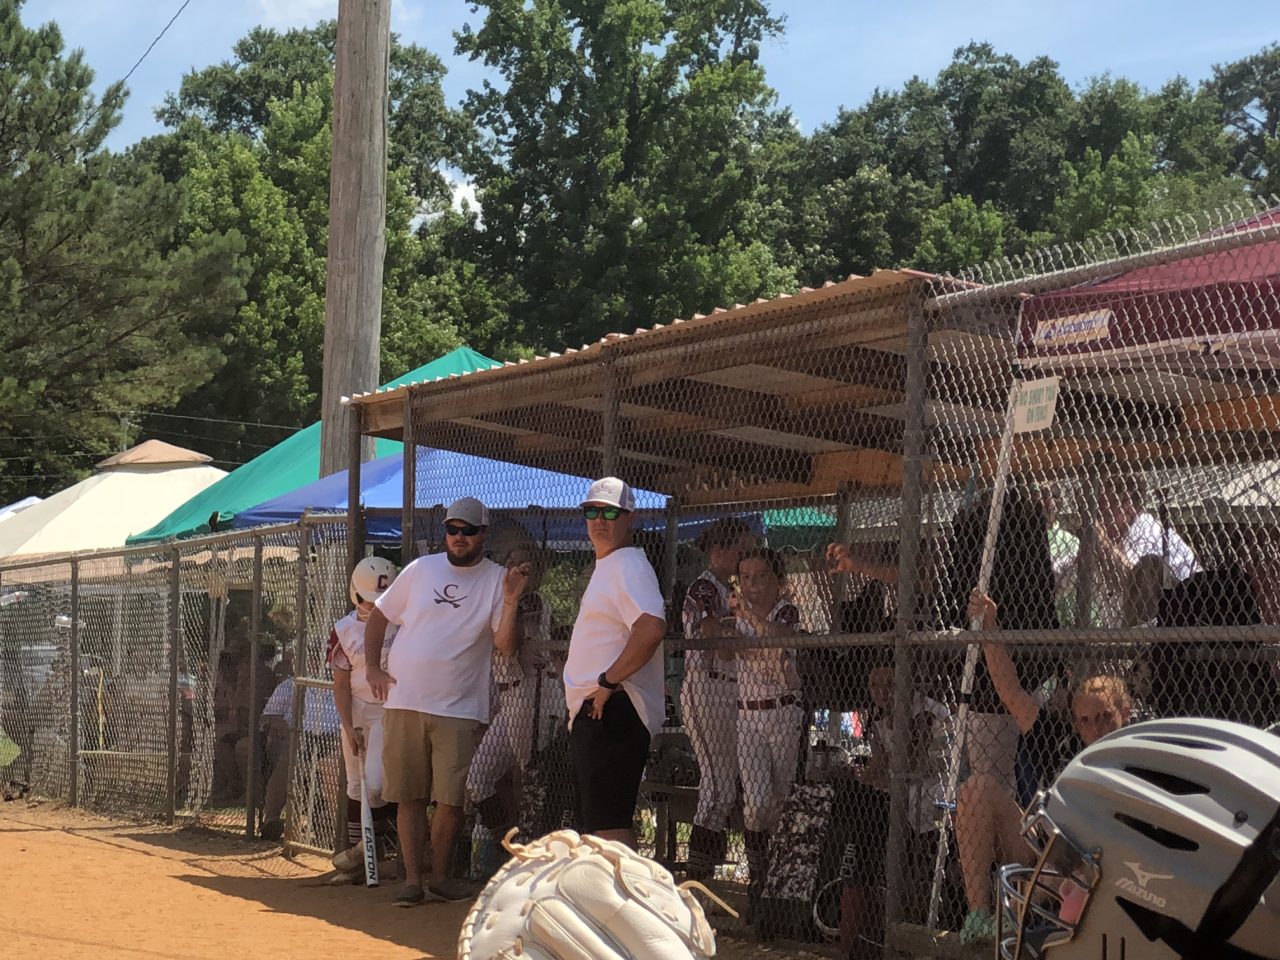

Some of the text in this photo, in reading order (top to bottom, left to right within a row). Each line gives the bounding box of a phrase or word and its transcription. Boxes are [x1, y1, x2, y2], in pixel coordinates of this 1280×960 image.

[377, 575, 388, 589] C
[443, 584, 458, 599] C
[364, 827, 377, 881] EASTON
